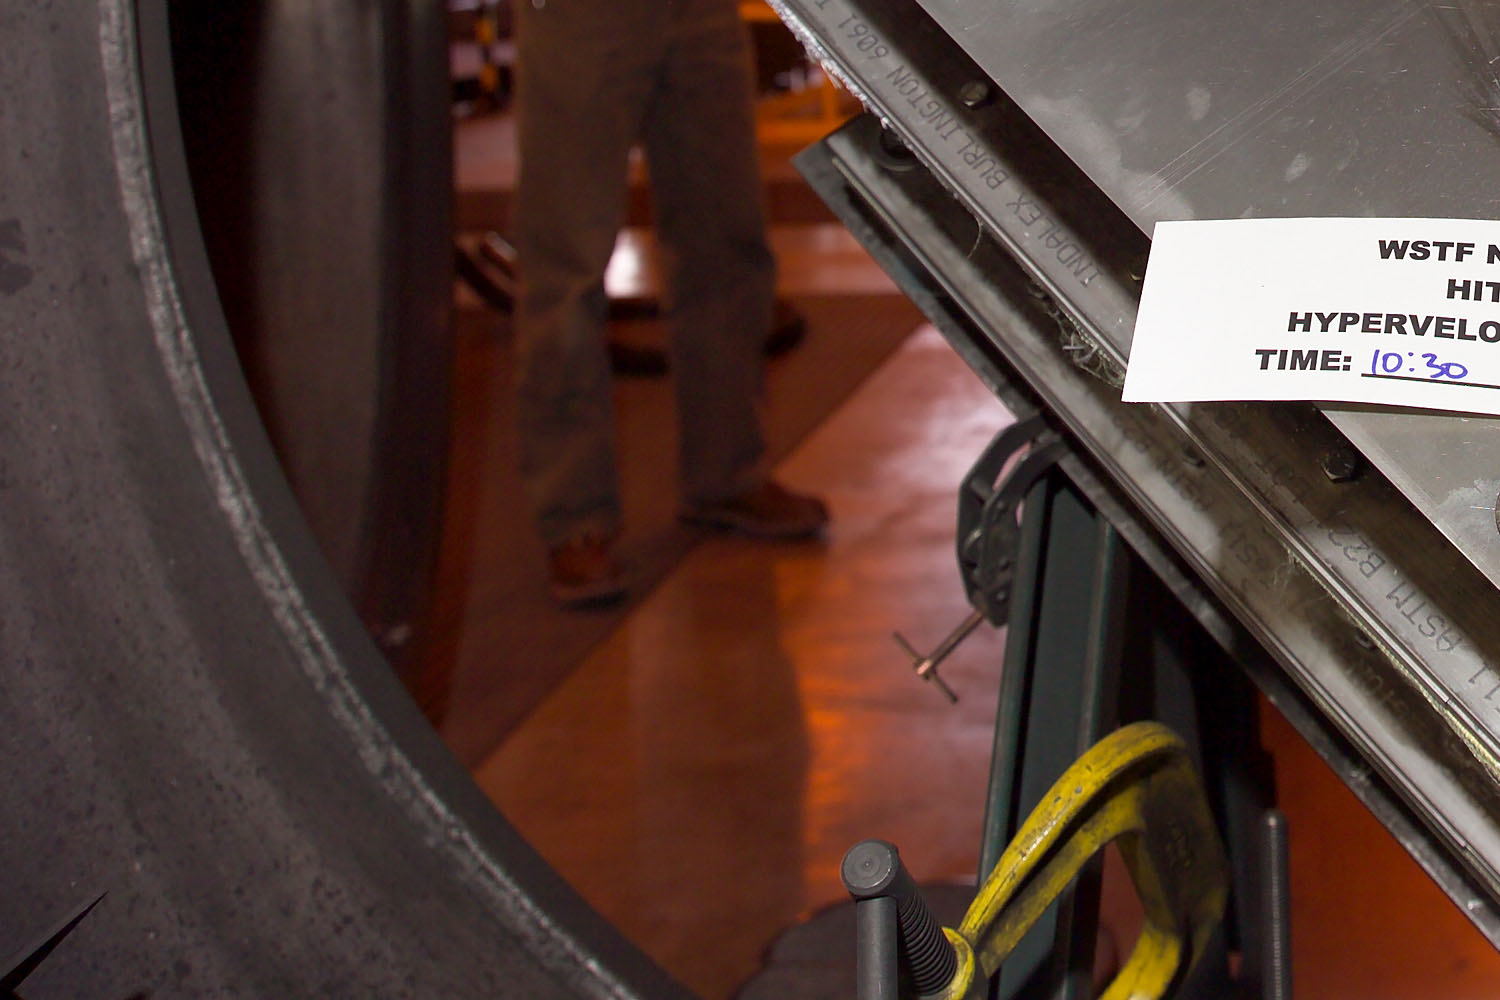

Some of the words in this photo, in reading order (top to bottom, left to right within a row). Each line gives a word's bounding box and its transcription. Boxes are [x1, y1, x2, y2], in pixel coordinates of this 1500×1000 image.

[837, 11, 889, 63] 6061
[885, 64, 1010, 191] BURLINGTON
[1006, 192, 1104, 288] INDALEX
[1379, 240, 1475, 262] WSTF
[1256, 350, 1351, 371] TIME:
[1370, 348, 1468, 380] 10:30
[1385, 579, 1463, 655] ASTM
